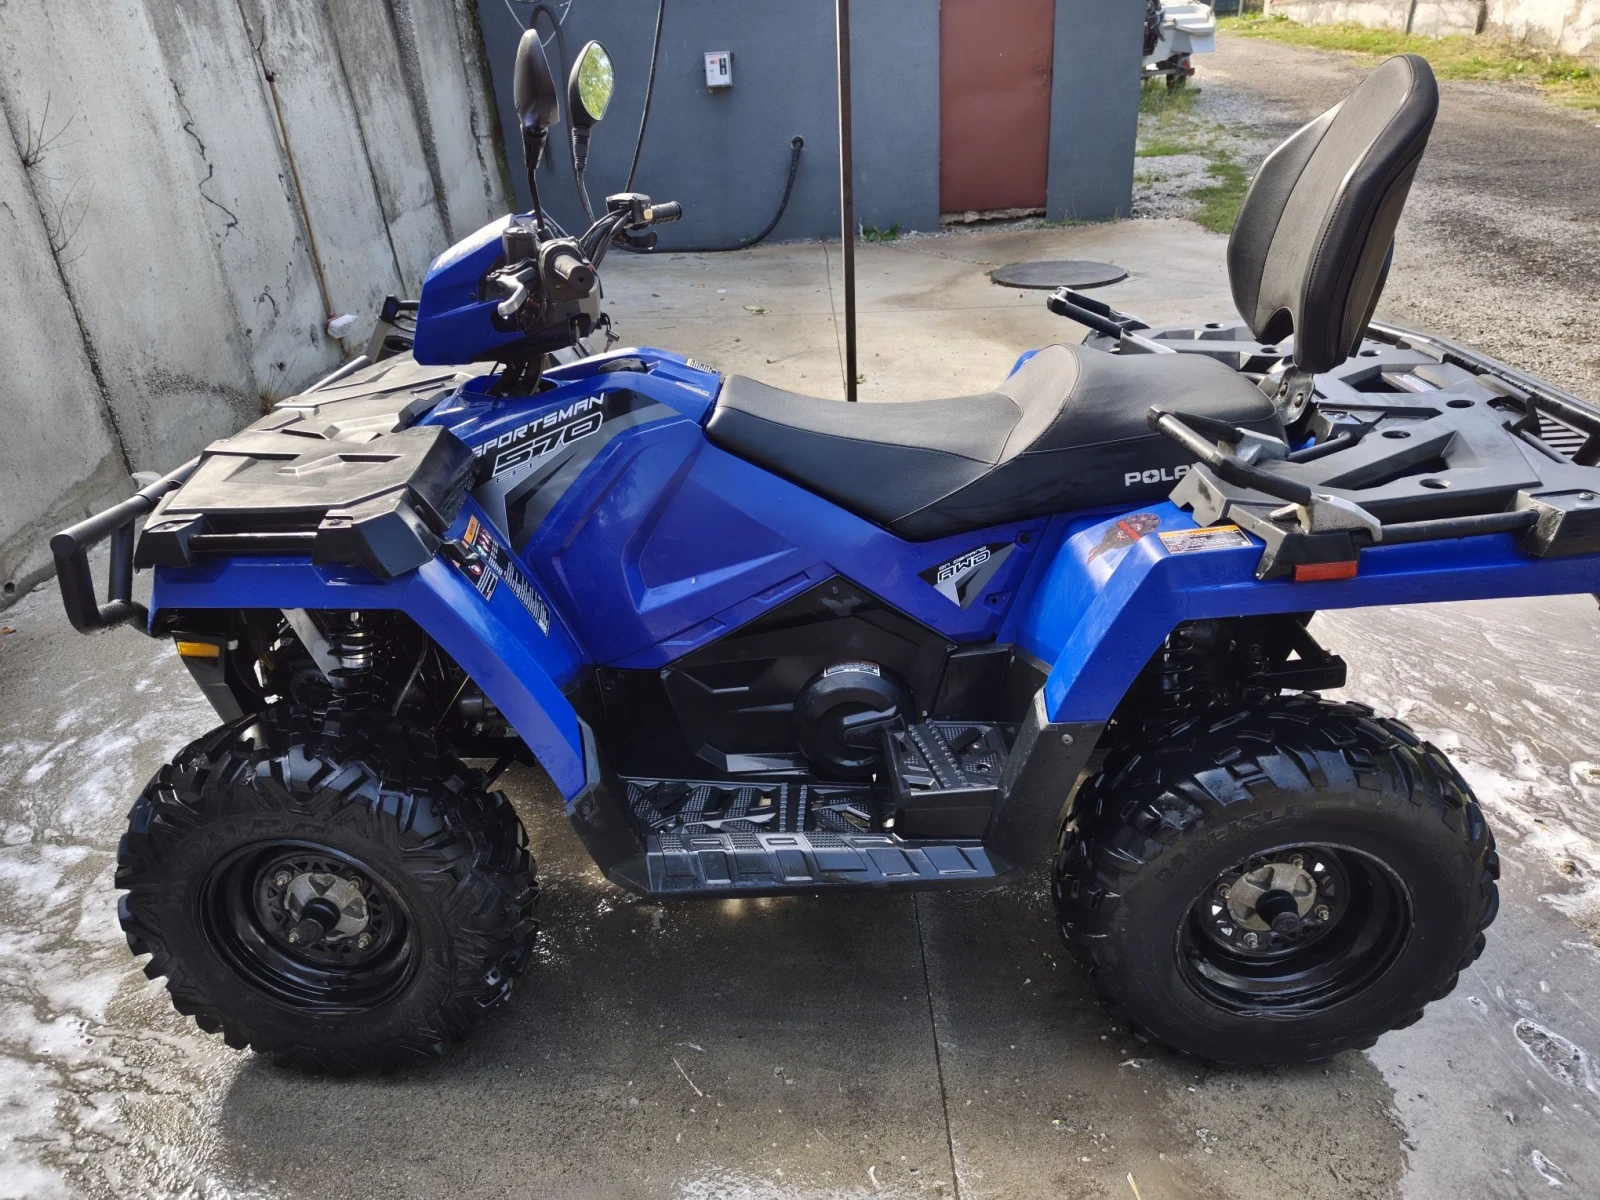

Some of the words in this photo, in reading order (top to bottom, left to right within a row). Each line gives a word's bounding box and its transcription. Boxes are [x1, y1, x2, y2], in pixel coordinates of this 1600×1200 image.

[472, 392, 605, 458] SPORTSMAN
[492, 411, 603, 478] 570
[1124, 464, 1196, 487] POLA
[937, 549, 990, 584] AWD
